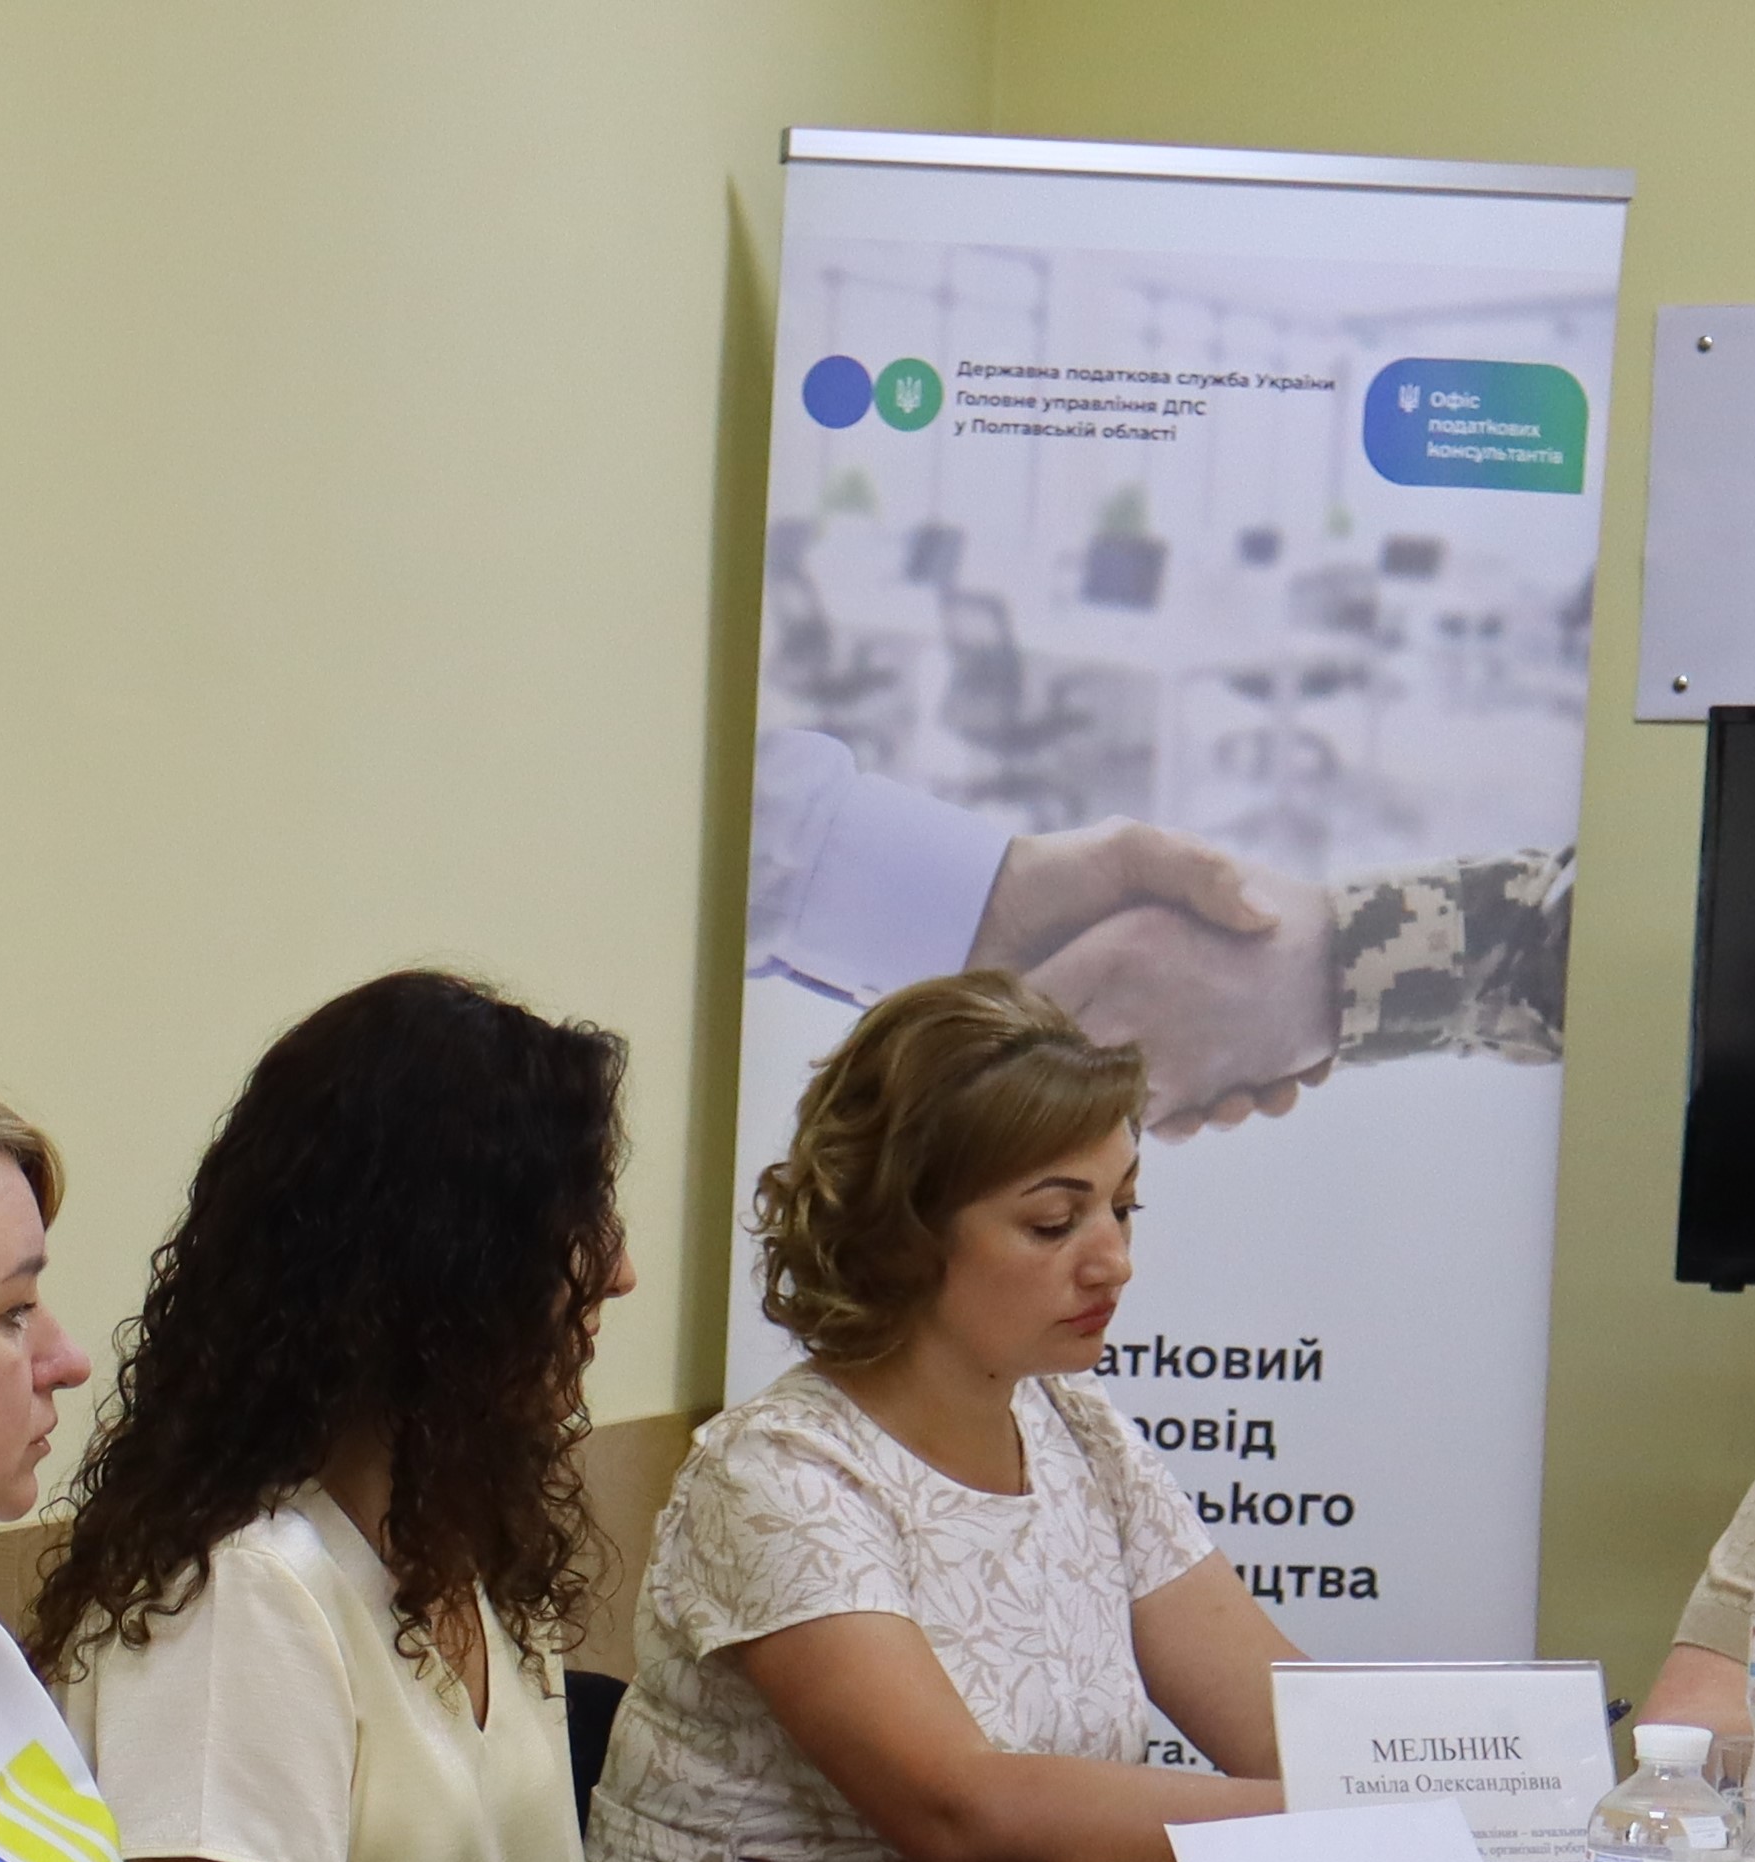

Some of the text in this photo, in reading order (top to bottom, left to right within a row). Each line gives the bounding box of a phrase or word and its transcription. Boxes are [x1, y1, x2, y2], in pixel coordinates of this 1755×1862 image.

[957, 361, 1336, 393] Державна податкова служба України
[956, 390, 1207, 416] Головне управління ДПС
[1429, 391, 1481, 410] Офіс
[954, 418, 1177, 441] у Полтавській області
[1428, 418, 1541, 438] податкових
[1426, 440, 1563, 464] консультантів
[1093, 1335, 1323, 1382] атковий
[1184, 1482, 1355, 1527] ького
[1371, 1736, 1523, 1763] МЕЛЬНИК
[1340, 1771, 1562, 1796] Таміла Олександрівна
